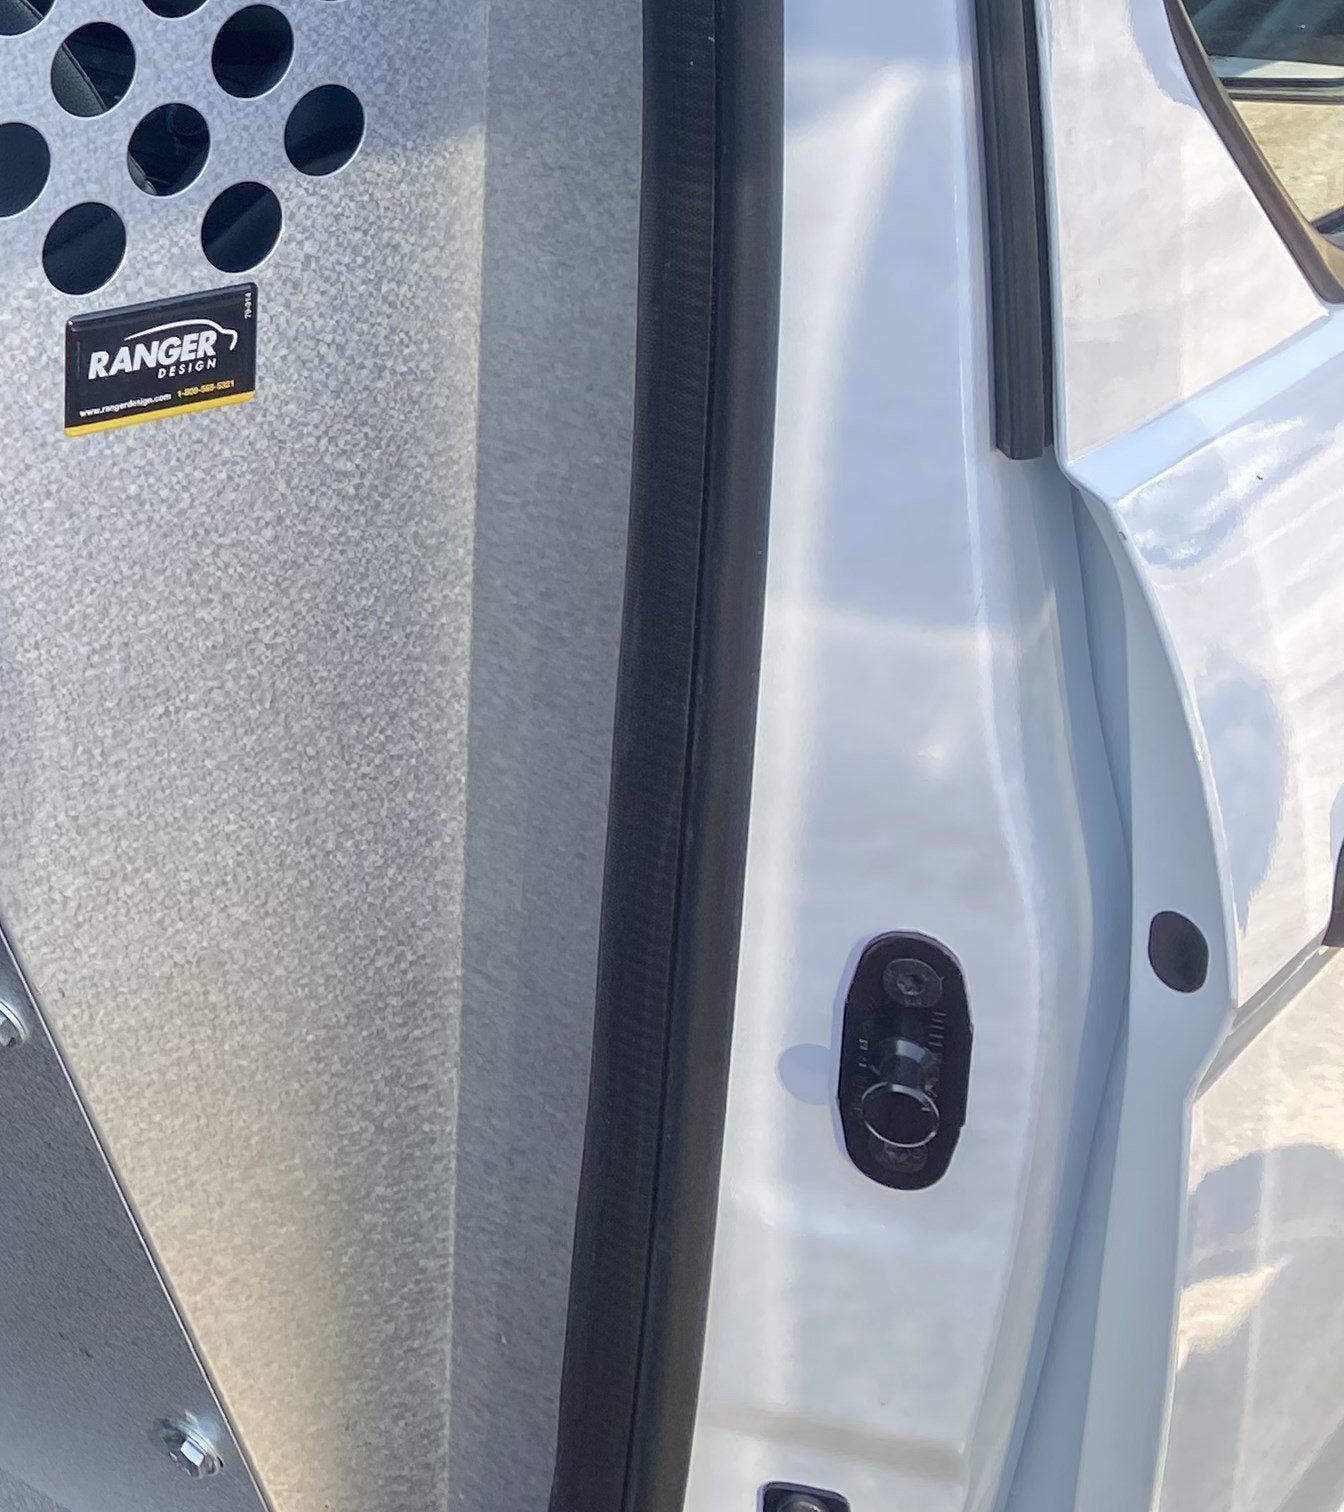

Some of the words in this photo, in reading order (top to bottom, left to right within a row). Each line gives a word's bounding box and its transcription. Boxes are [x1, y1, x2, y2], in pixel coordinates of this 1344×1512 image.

[88, 330, 218, 380] RANGER
[157, 358, 217, 379] DESIGN
[79, 393, 172, 417] www.rangerdesign.com
